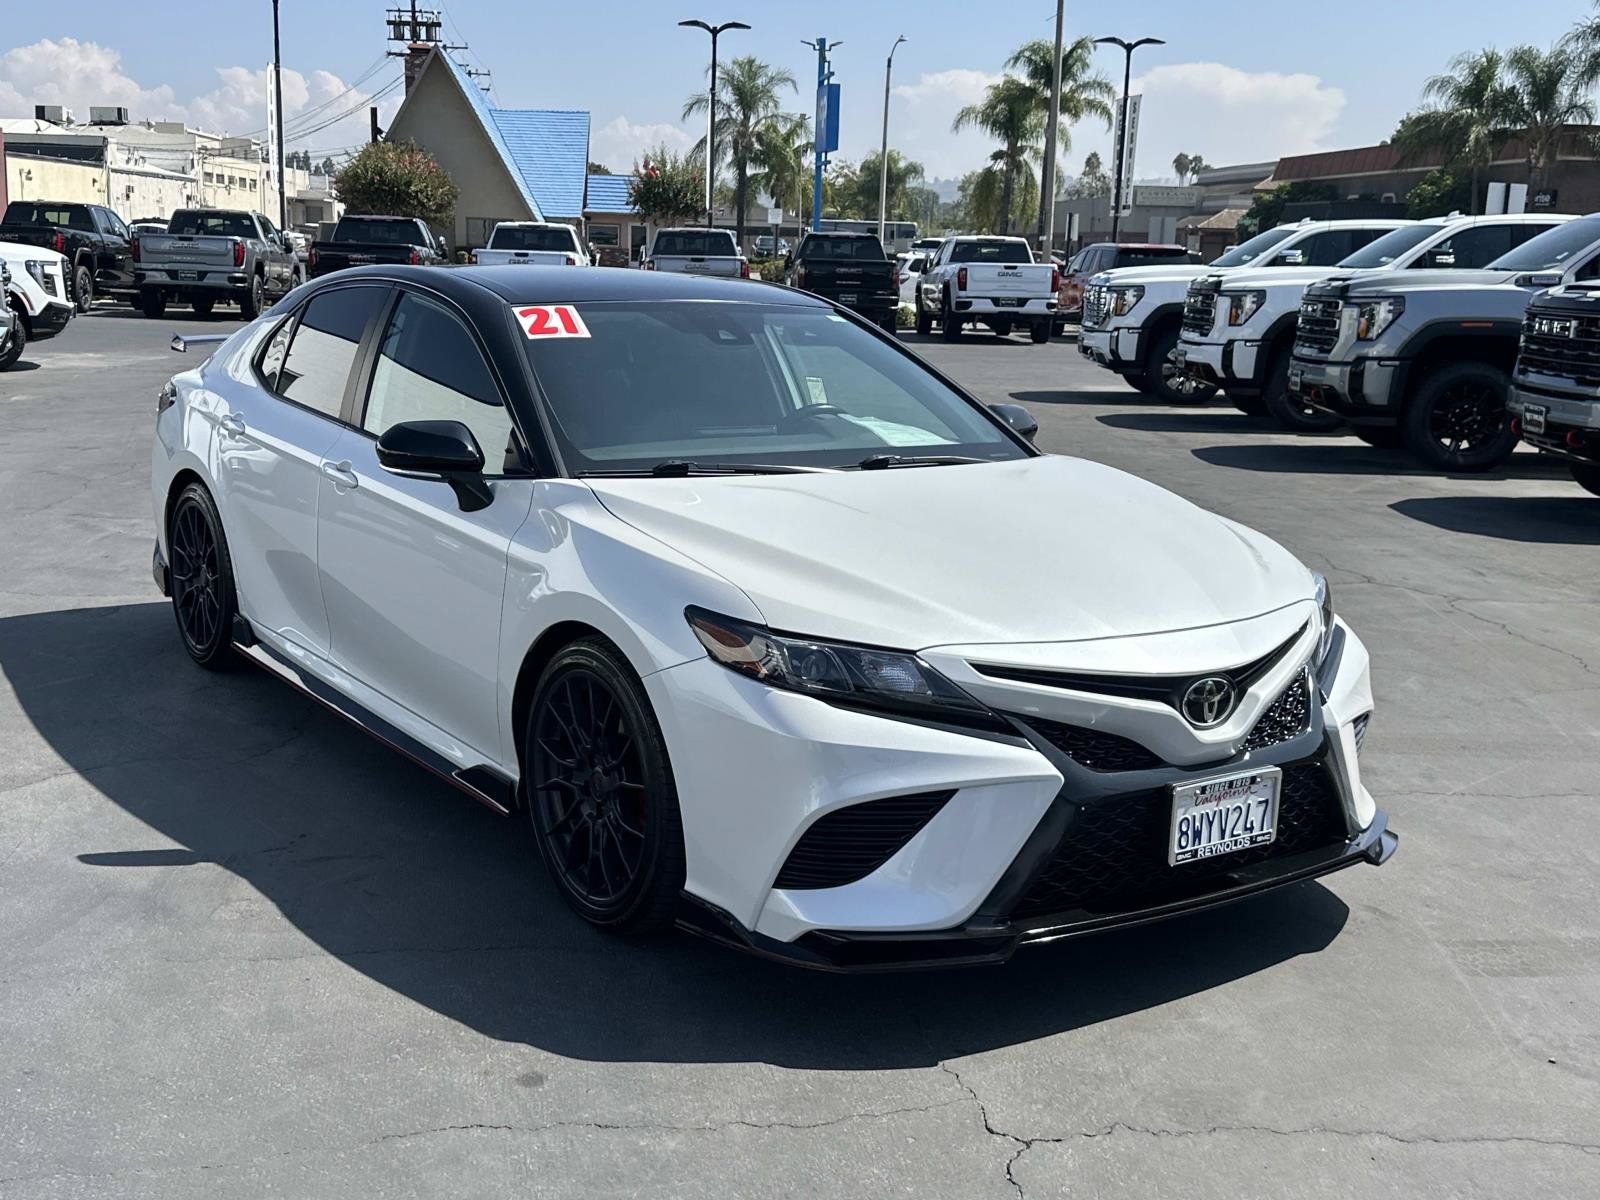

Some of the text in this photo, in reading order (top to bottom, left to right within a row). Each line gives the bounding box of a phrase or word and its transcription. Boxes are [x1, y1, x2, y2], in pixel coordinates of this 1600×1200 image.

[518, 307, 579, 335] 21
[1194, 786, 1257, 806] California
[1206, 780, 1230, 794] SINCE
[1178, 798, 1270, 851] 8WYV247
[1197, 837, 1251, 858] REYNOLDS
